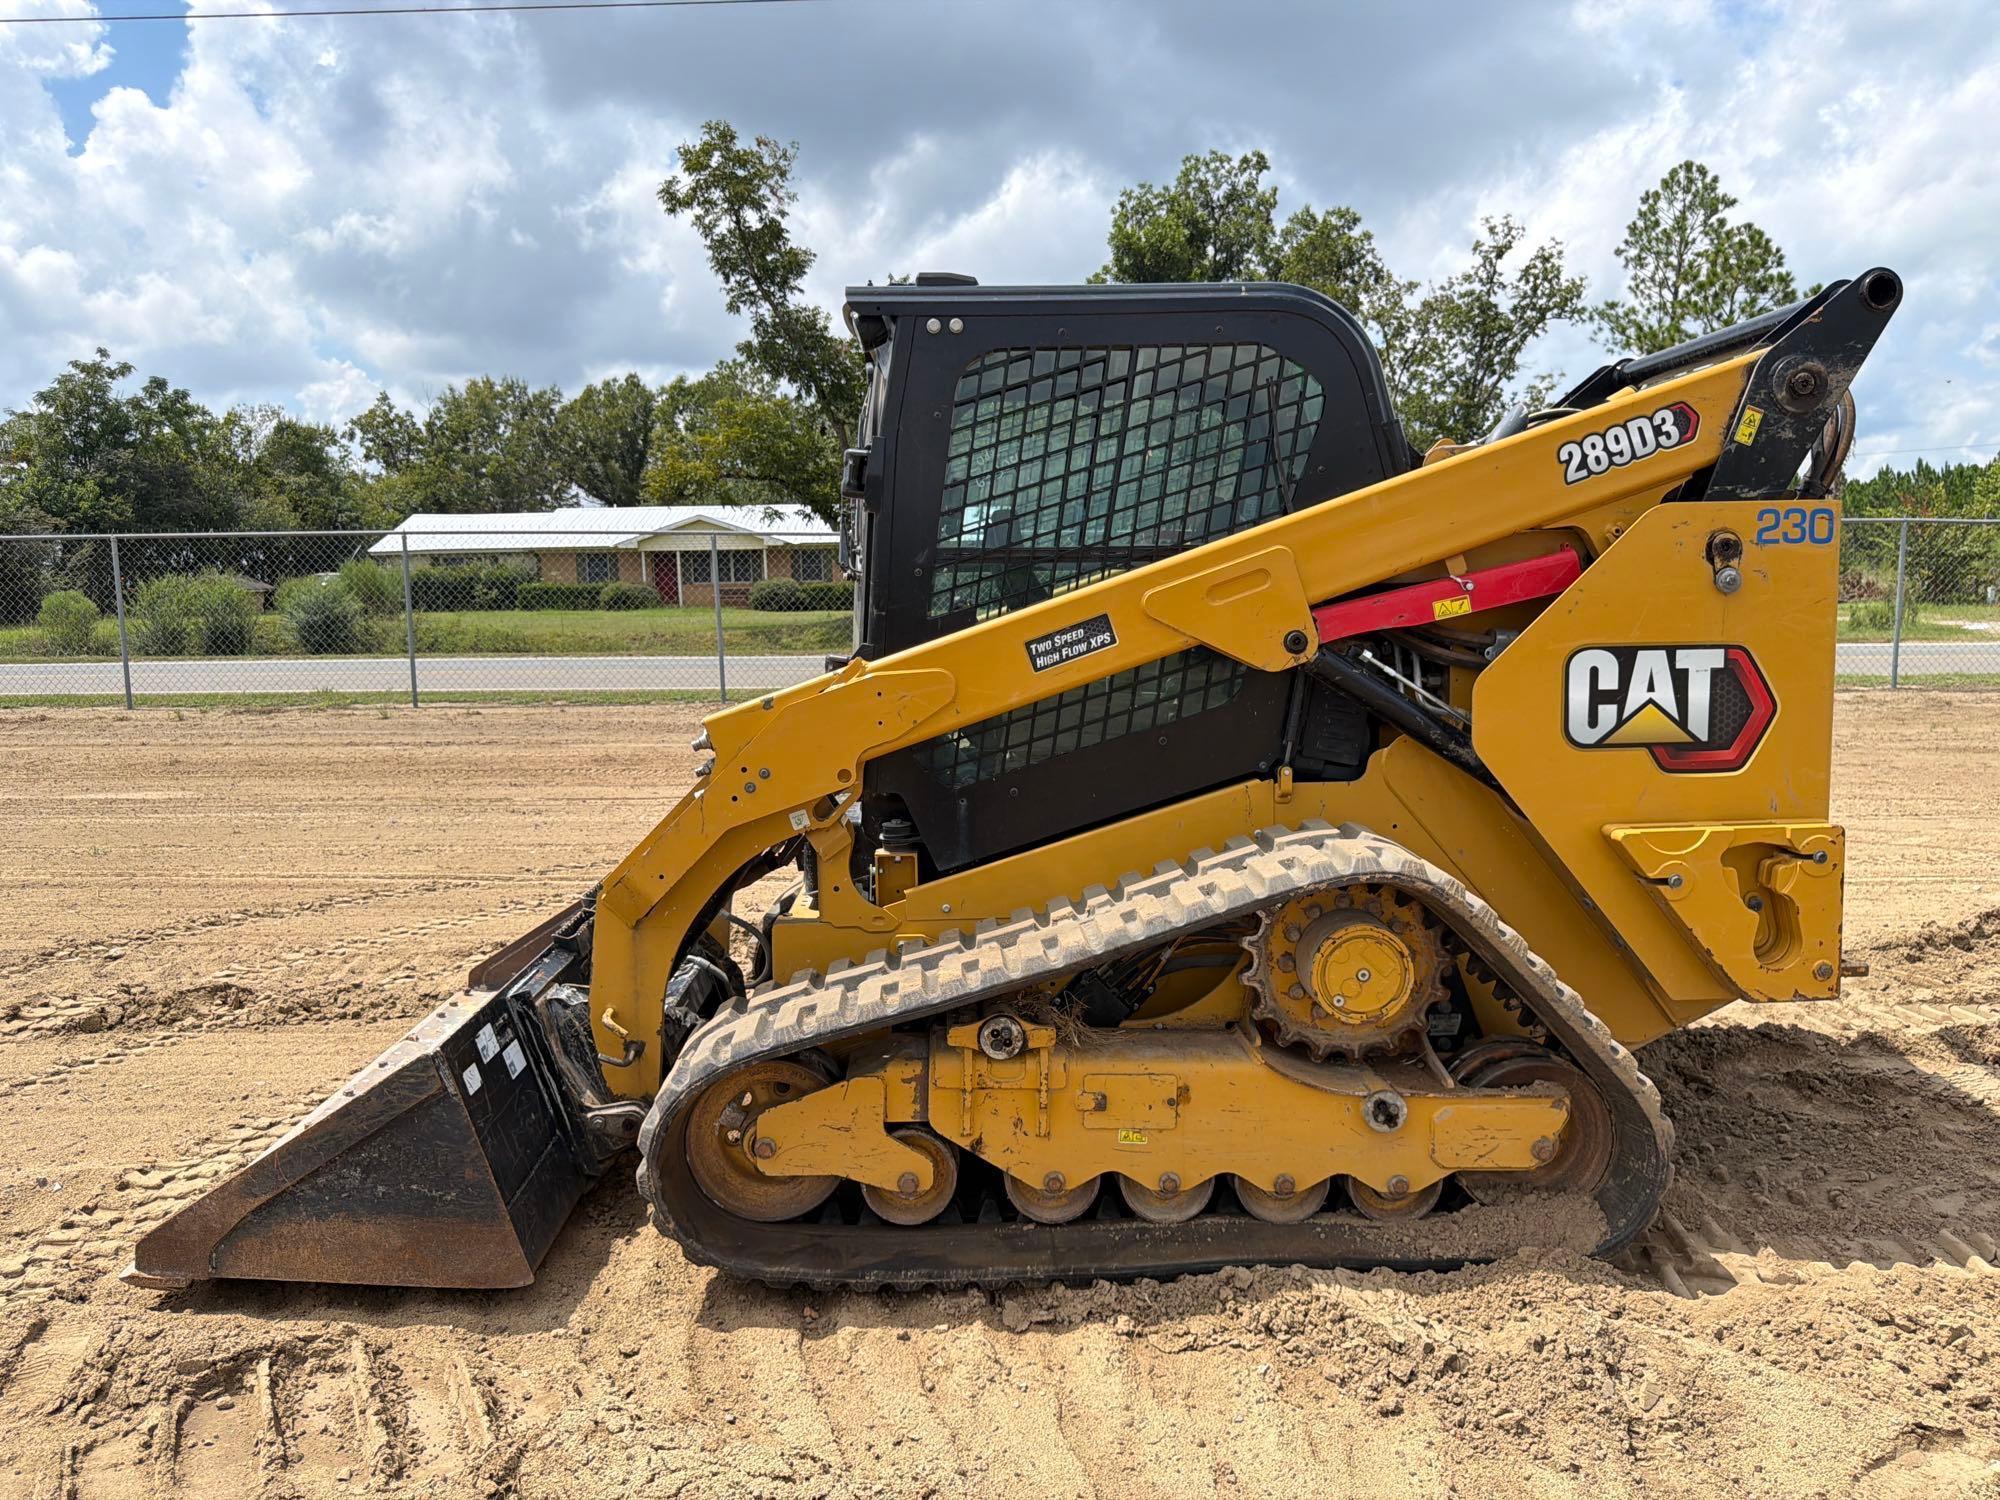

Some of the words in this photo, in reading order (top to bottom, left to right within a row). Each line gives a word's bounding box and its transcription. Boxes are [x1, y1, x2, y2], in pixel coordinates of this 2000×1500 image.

[1559, 409, 1680, 484] 289D3
[1757, 508, 1834, 545] 230
[1030, 639, 1052, 656] TWO
[1054, 628, 1084, 647] SPEED
[1036, 651, 1060, 669] HIGH
[1061, 642, 1088, 659] FLOW
[1089, 632, 1111, 649] XPS
[1567, 648, 1725, 745] CAT
